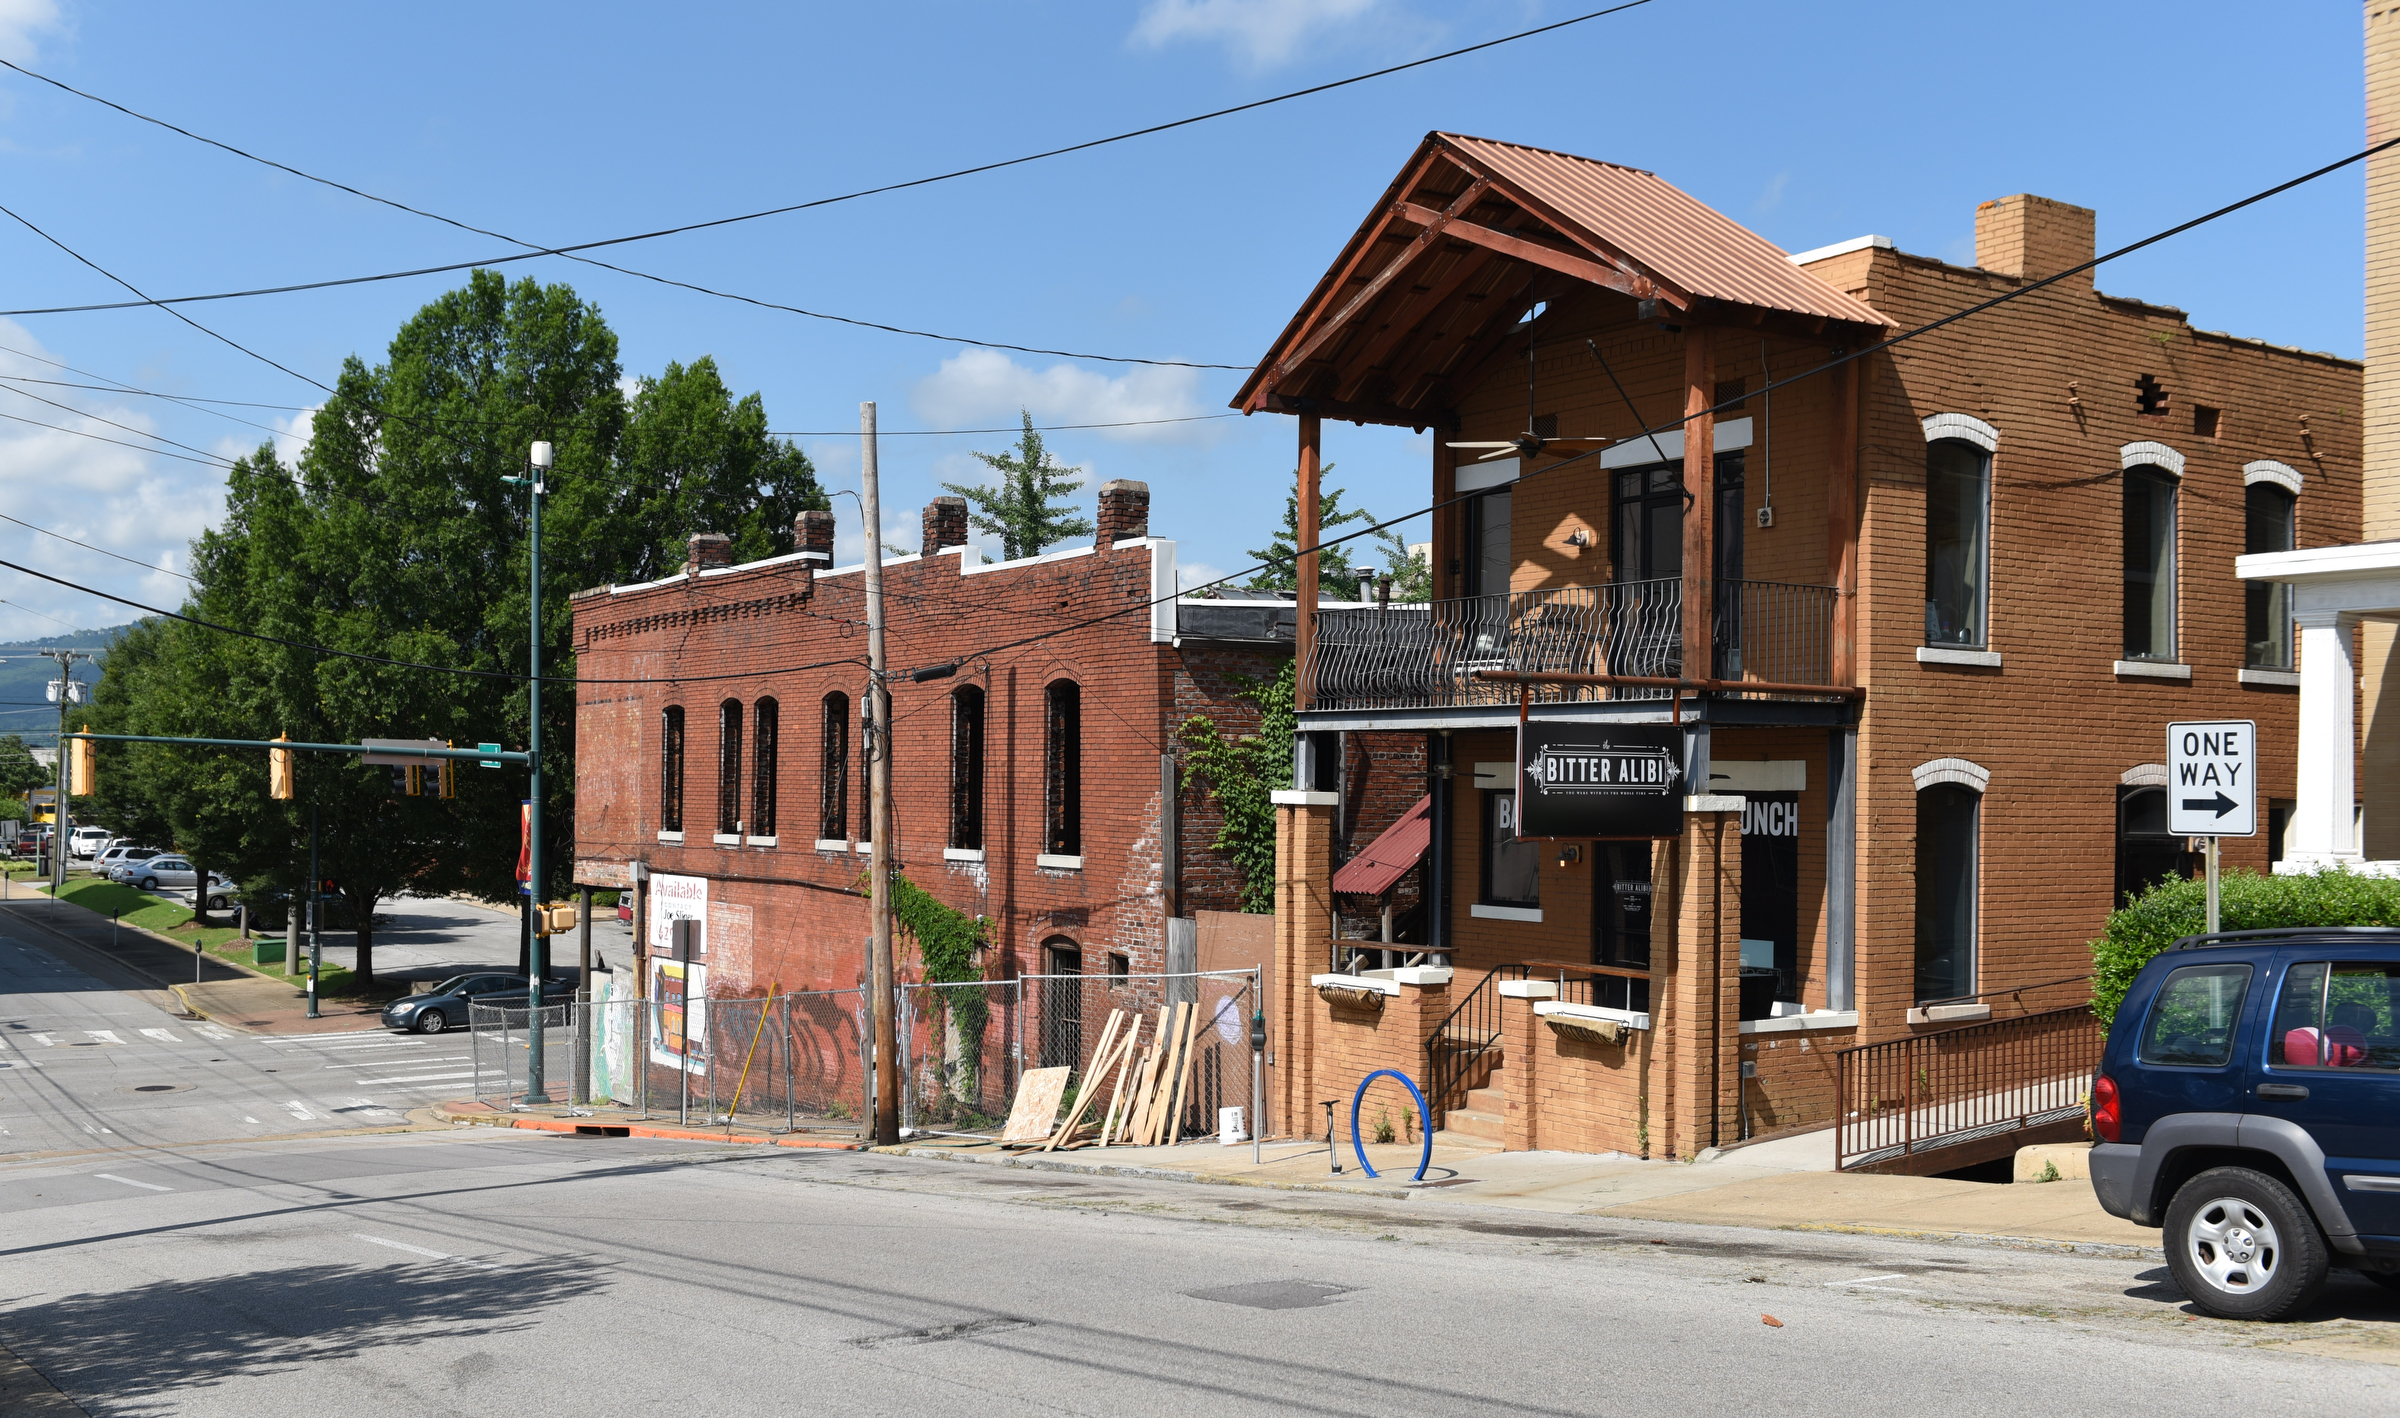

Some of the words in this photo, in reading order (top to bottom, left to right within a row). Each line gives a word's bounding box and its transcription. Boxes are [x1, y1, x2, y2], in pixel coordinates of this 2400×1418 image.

[2183, 732, 2239, 756] ONE
[1546, 757, 1611, 782] BITTER
[1618, 758, 1663, 783] ALIBI
[2179, 763, 2243, 787] WAY
[655, 880, 703, 900] Available
[1617, 883, 1633, 891] BITTER
[663, 909, 674, 920] Joe
[664, 902, 692, 910] CONTACT
